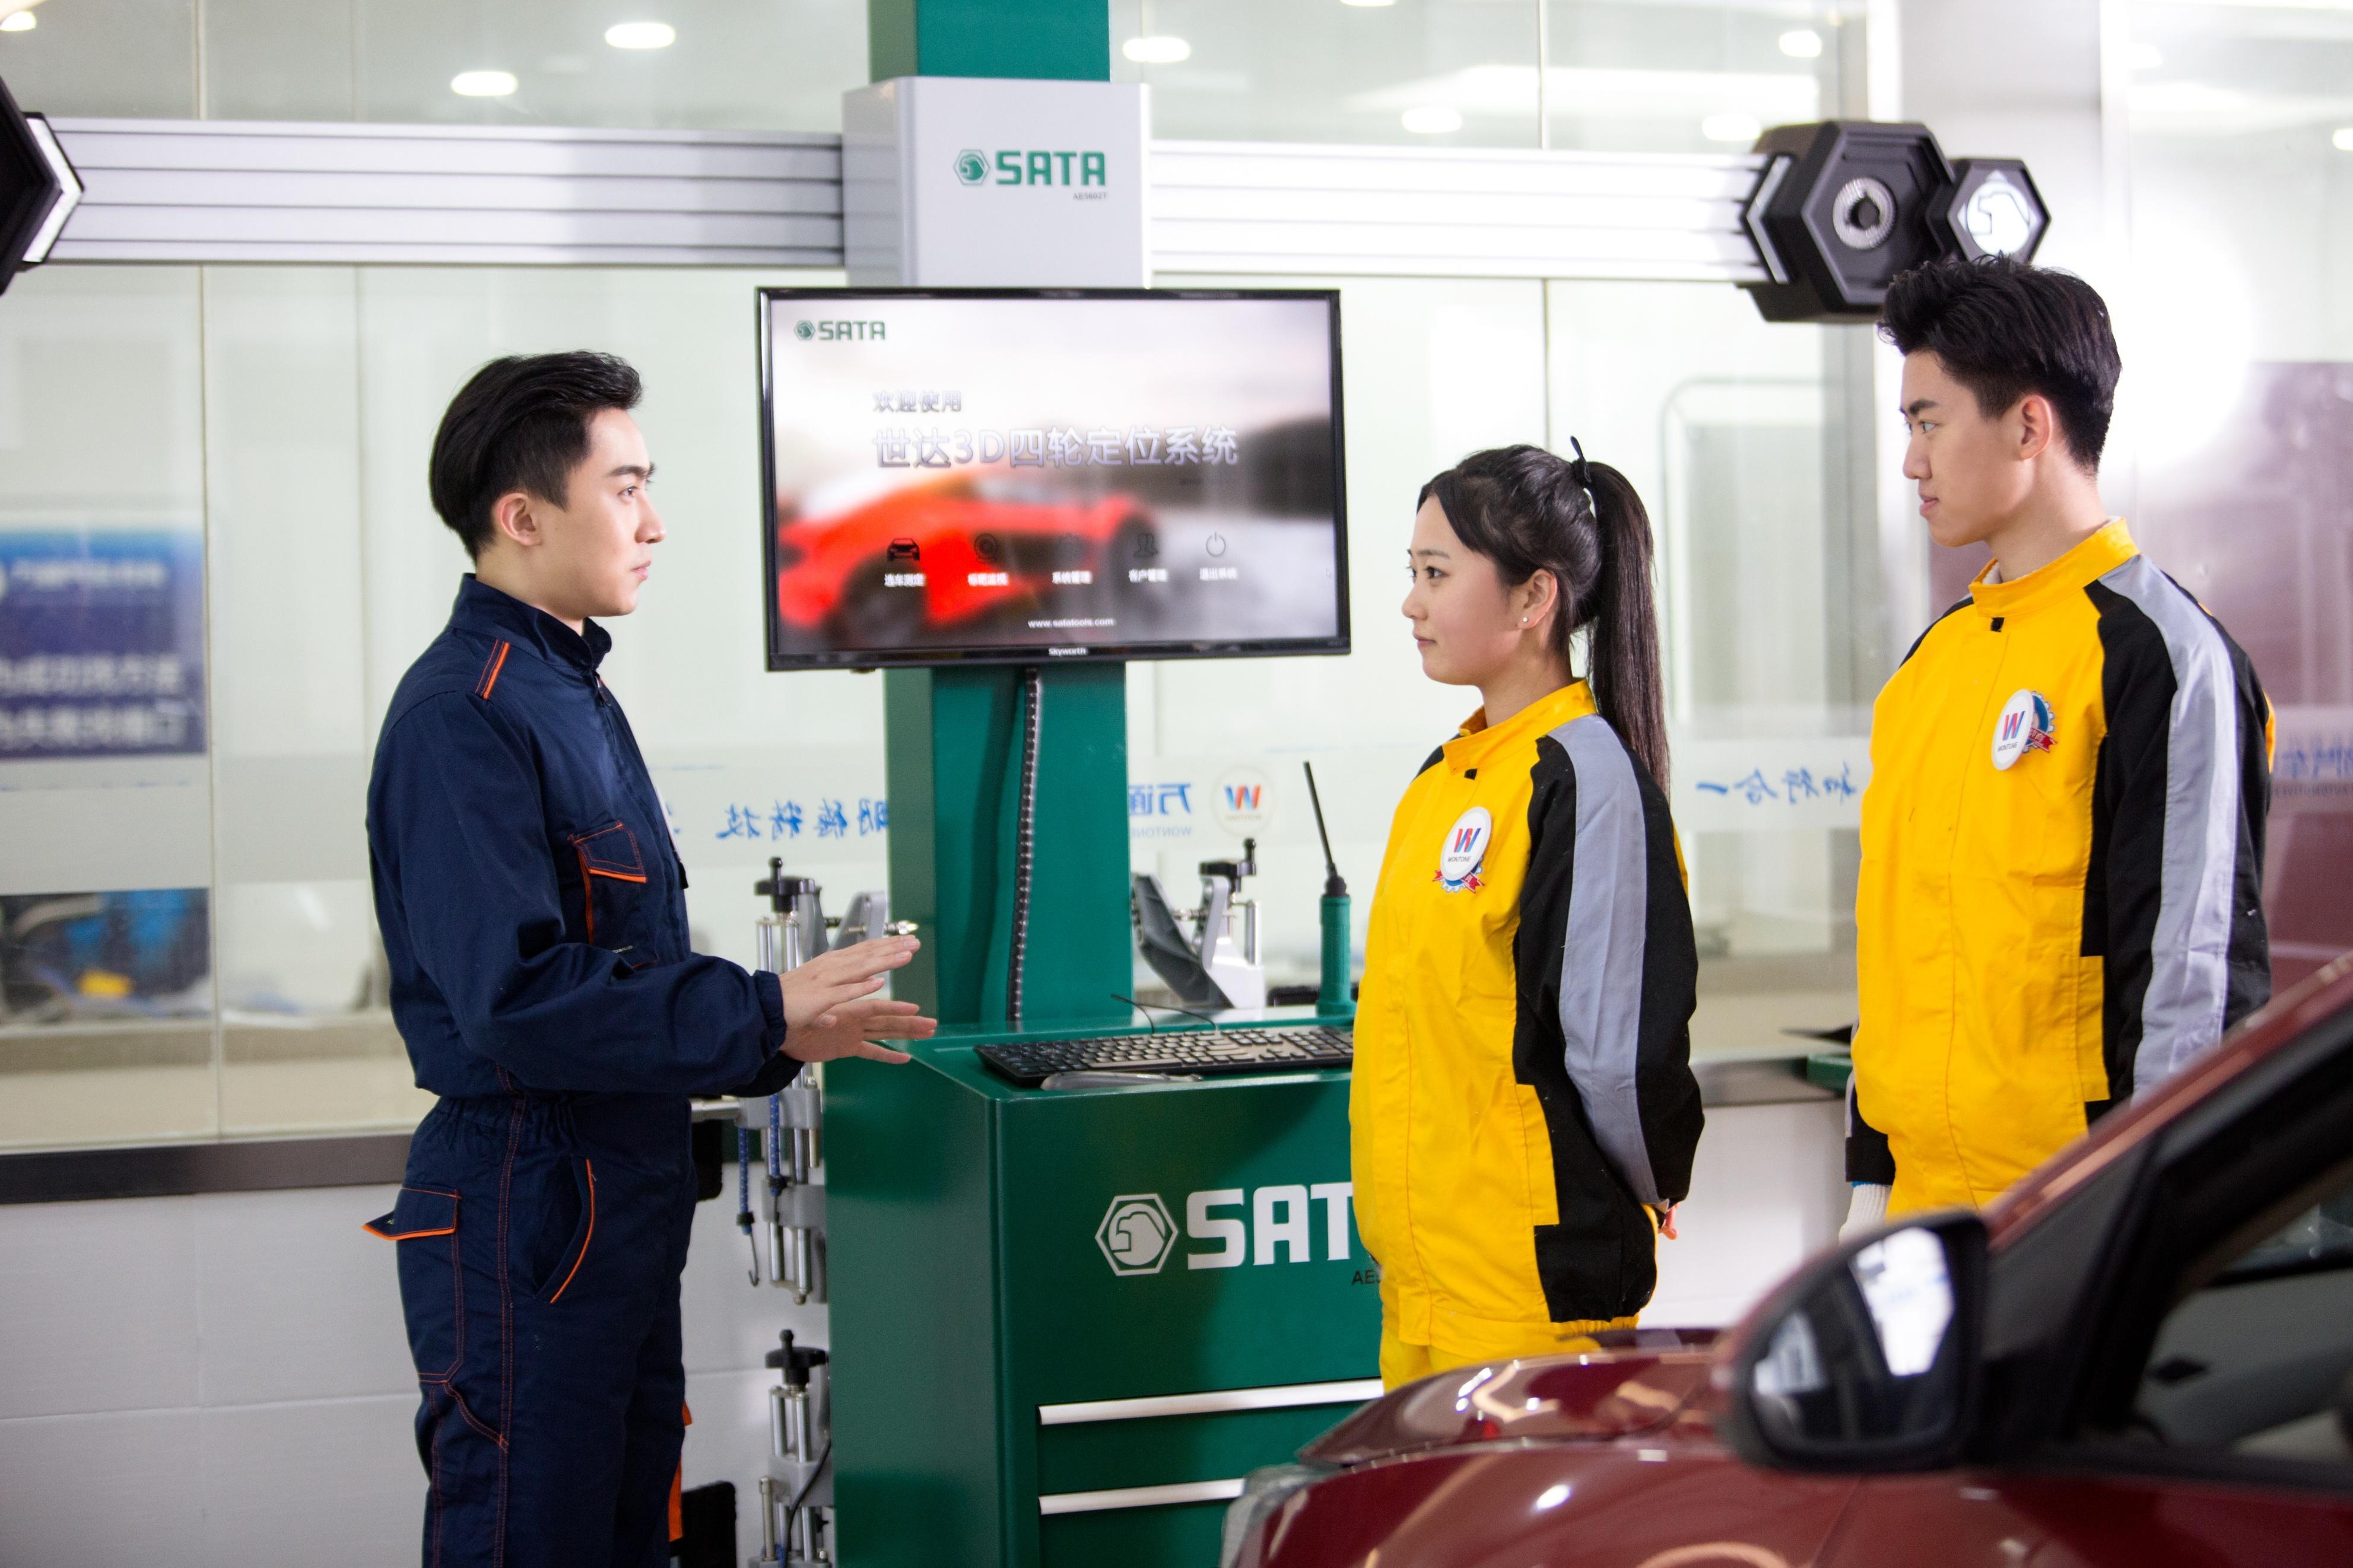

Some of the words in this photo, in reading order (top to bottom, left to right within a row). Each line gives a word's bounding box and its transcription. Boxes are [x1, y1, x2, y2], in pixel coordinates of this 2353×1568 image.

[996, 151, 1106, 186] SATA
[818, 320, 885, 340] SATA
[873, 390, 962, 412] 欢迎使用
[872, 426, 1238, 468] 世达3D四轮定位系统
[1028, 618, 1114, 628] www.satatools.com
[1048, 647, 1087, 657] Skyworth
[1186, 1181, 1354, 1270] SAT
